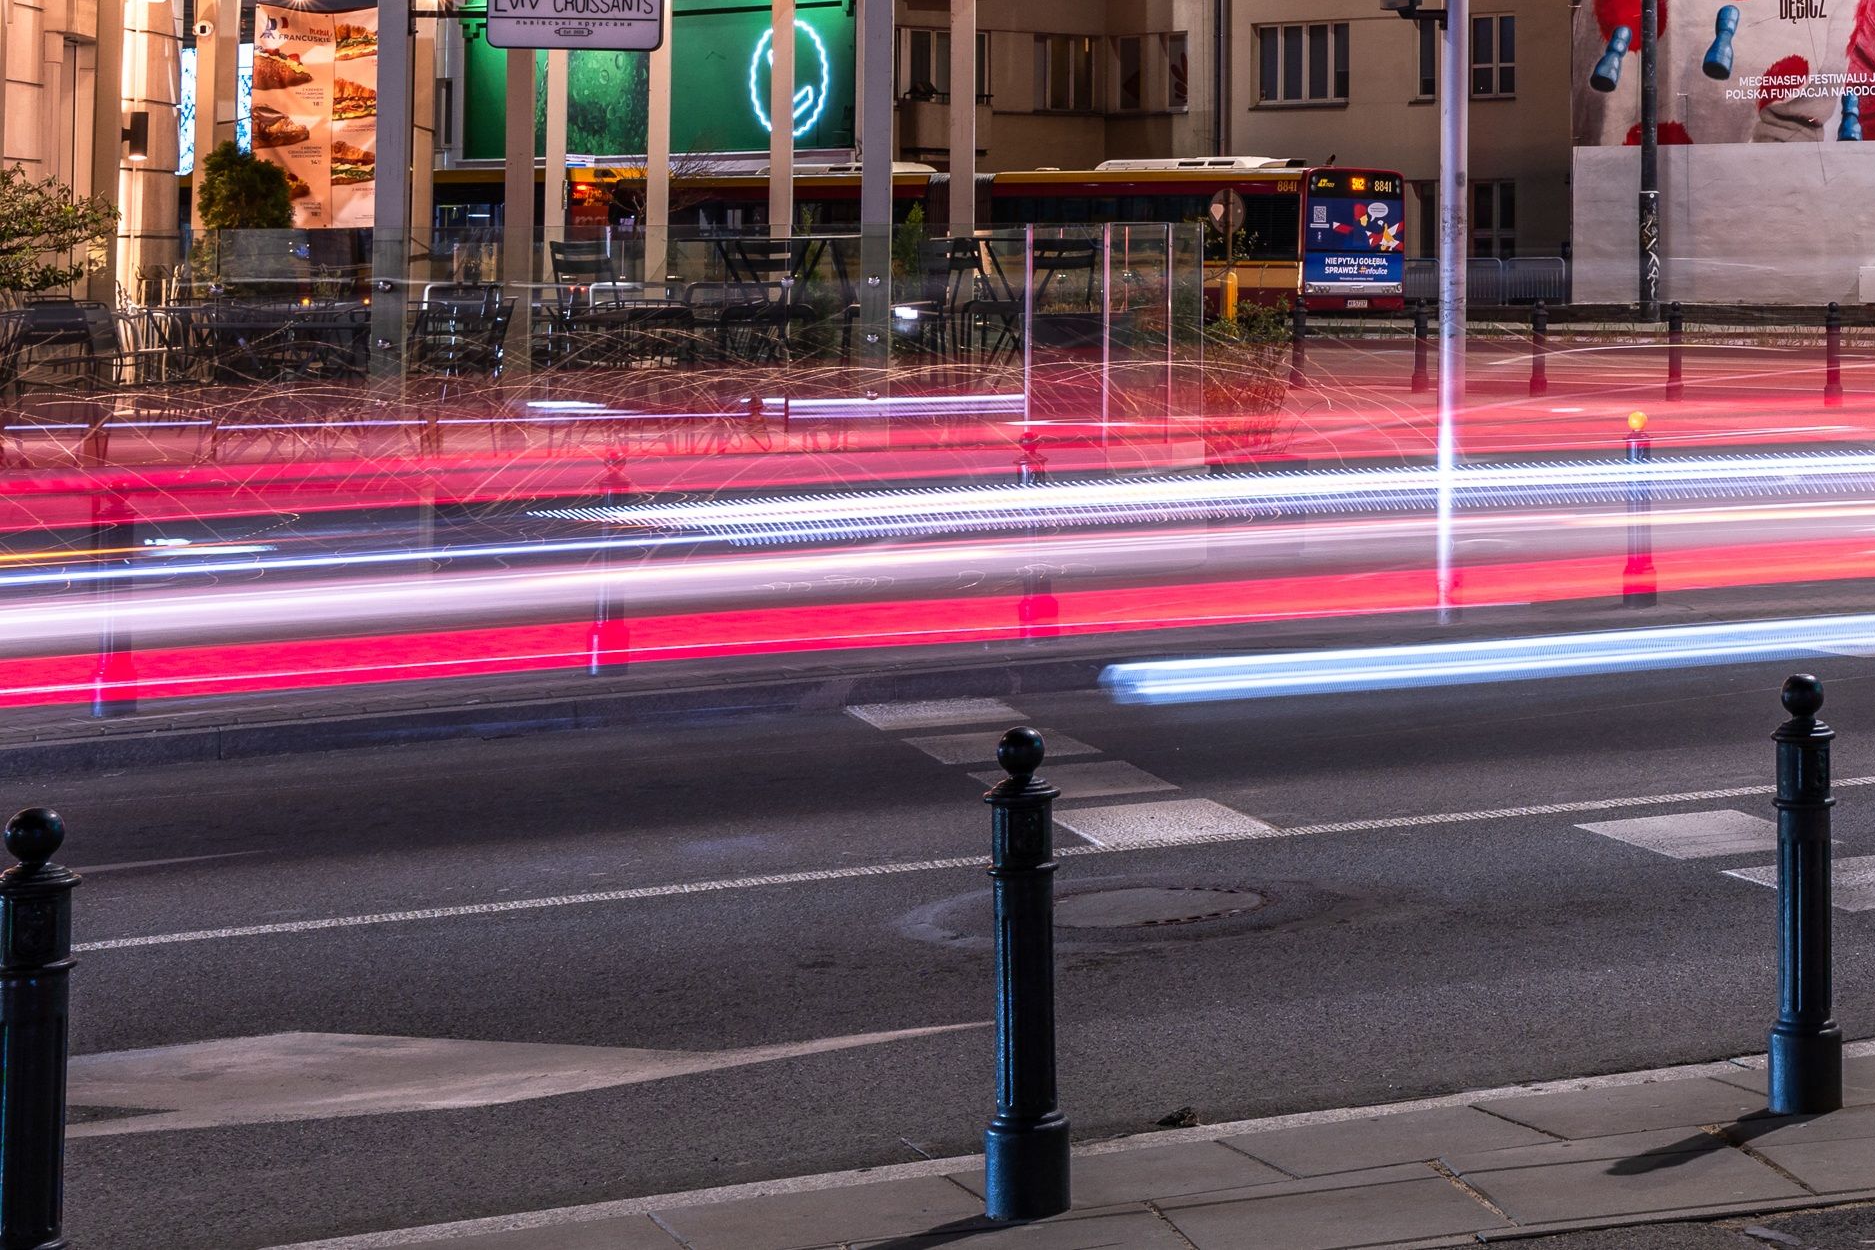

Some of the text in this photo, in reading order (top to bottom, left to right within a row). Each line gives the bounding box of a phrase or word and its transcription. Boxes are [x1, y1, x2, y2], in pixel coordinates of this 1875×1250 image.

[577, 21, 633, 29] круасани
[1739, 73, 1807, 87] MECENASEM
[1808, 71, 1869, 86] FESTIWALU
[1725, 88, 1768, 100] POLSKA
[1770, 86, 1829, 100] FUNDACJA
[1277, 180, 1297, 192] 8841
[1374, 180, 1392, 192] 8841
[1325, 257, 1337, 265] NIE
[1337, 257, 1359, 265] PYTAJ
[1324, 264, 1358, 274] SPRAWDŹ
